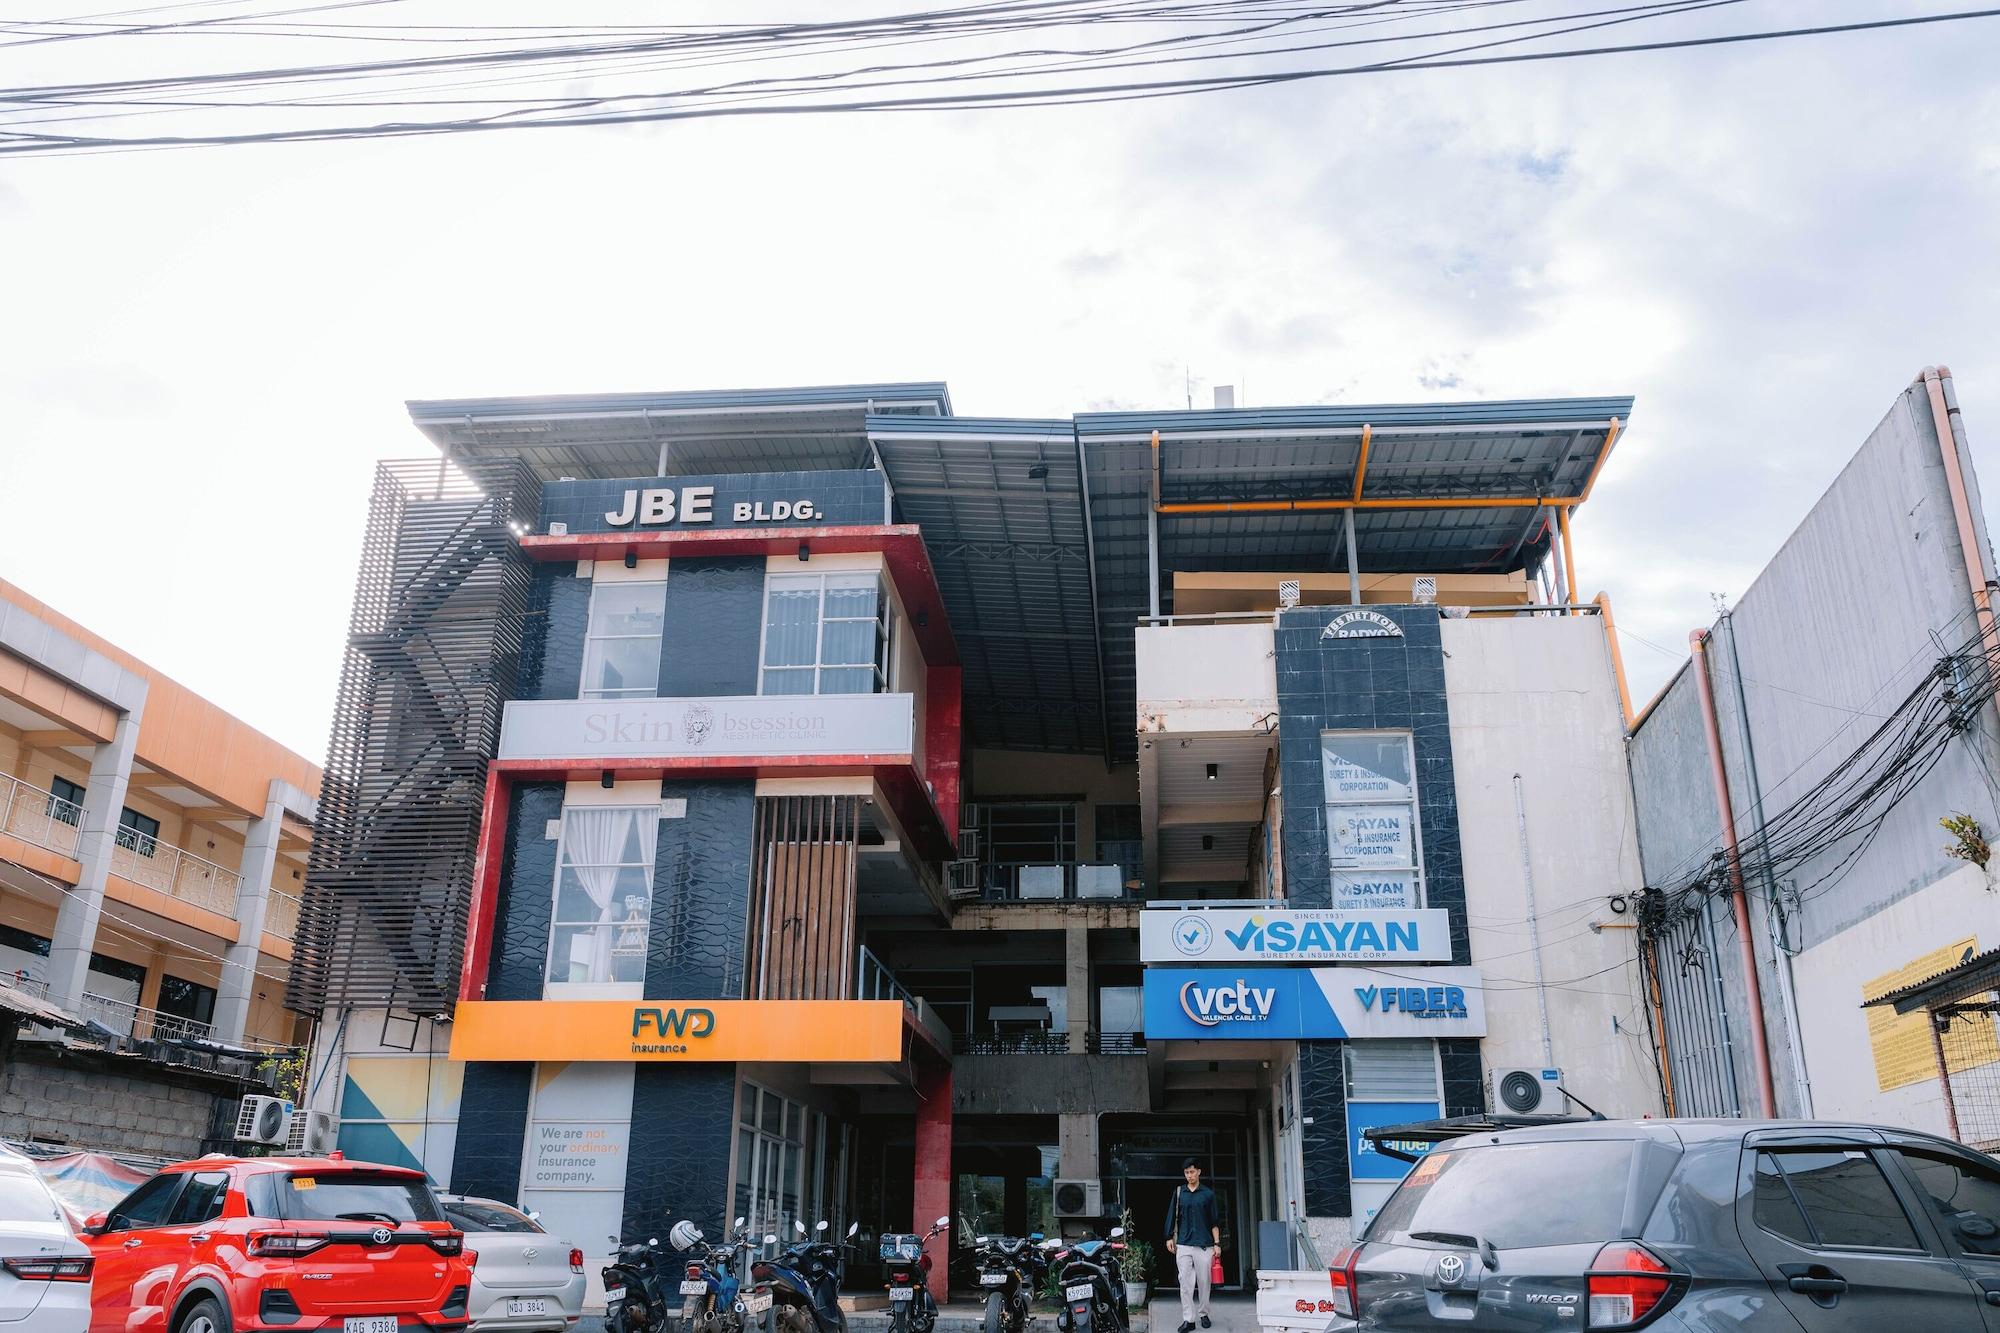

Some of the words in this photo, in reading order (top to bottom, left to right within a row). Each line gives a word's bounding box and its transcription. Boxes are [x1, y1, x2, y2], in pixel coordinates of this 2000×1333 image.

[604, 486, 714, 526] JBE
[733, 500, 823, 522] BLDG.
[583, 713, 673, 743] Skin
[789, 730, 826, 740] CLINIC
[1329, 770, 1352, 779] SURETY
[1340, 782, 1388, 791] CORPORATION
[1364, 832, 1400, 843] INSURANCE
[1344, 846, 1393, 855] CORPORATION
[1192, 979, 1276, 1015] vctv
[632, 1008, 715, 1038] FWD
[631, 1042, 687, 1053] insurance
[542, 1128, 561, 1139] We
[563, 1130, 583, 1139] are
[586, 1129, 606, 1139] not
[539, 1143, 567, 1156] your
[569, 1142, 620, 1156] ordinary
[538, 1156, 596, 1167] insurance
[536, 1172, 595, 1184] company.
[509, 1304, 523, 1312] NDJ
[346, 1322, 365, 1333] KAG
[371, 1321, 396, 1333] 9386
